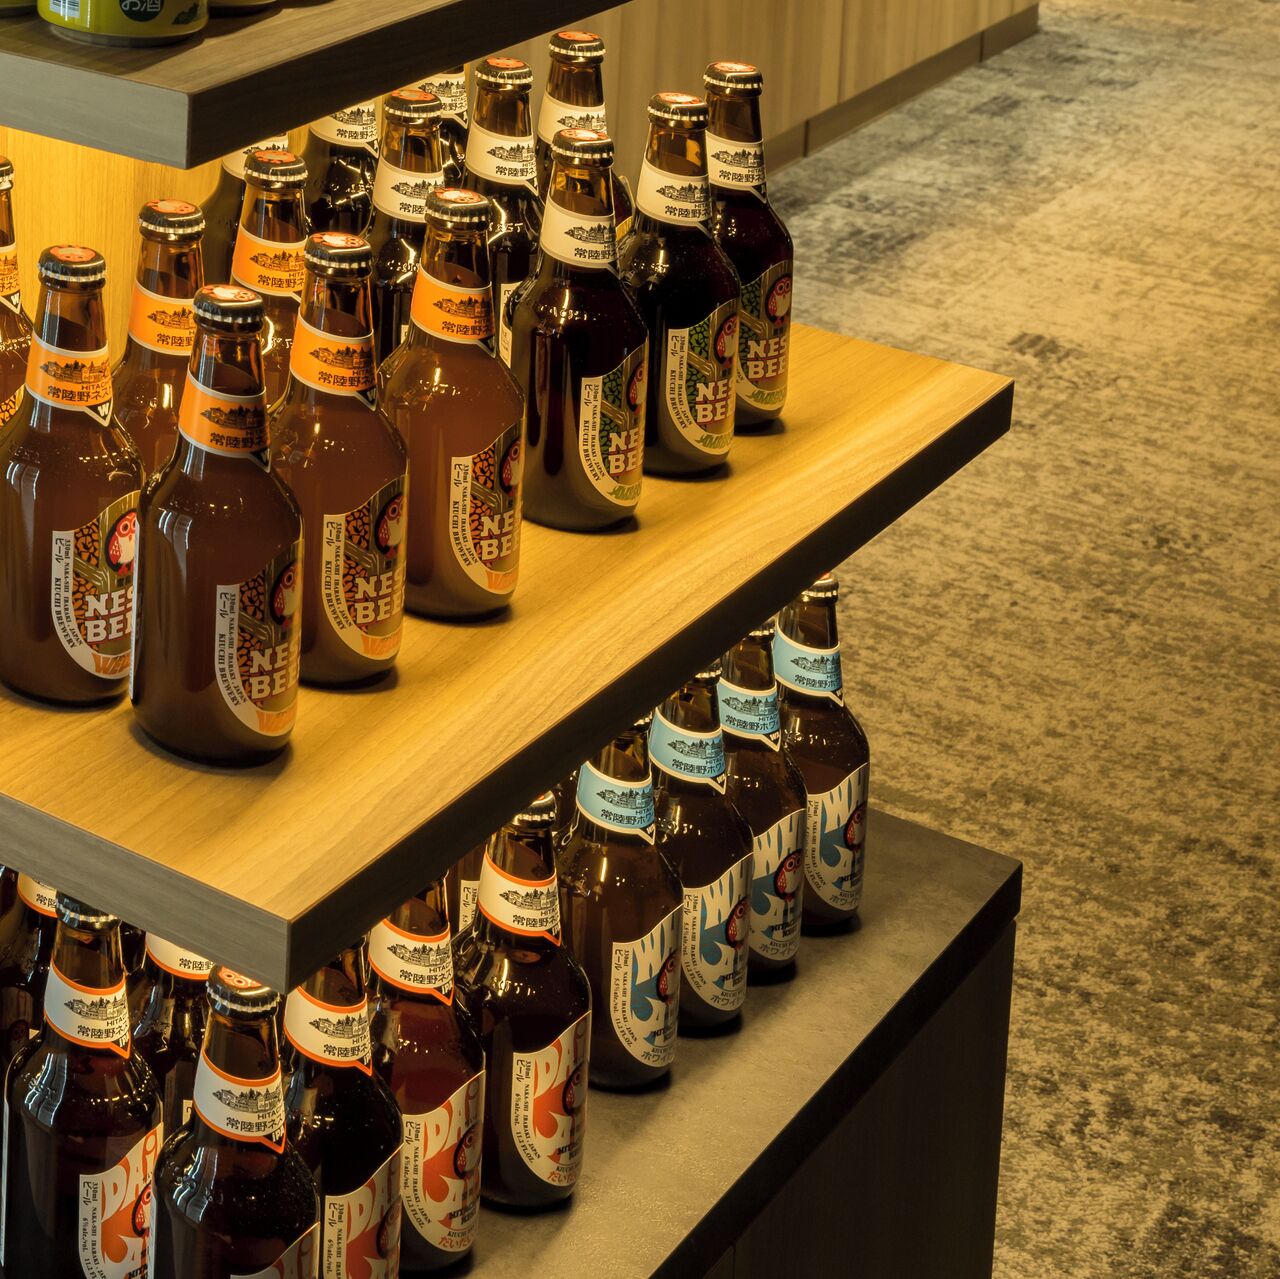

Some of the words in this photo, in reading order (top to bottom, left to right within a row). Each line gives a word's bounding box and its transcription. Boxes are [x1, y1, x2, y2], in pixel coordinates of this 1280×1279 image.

[671, 335, 680, 357] ビール
[47, 385, 110, 402] 常陸野ネス
[584, 383, 593, 407] ビール
[668, 397, 689, 430] BREWERY
[583, 420, 591, 449] KIUCHI
[454, 463, 463, 487] ビール
[583, 451, 601, 483] BREWERY
[452, 500, 460, 531] KIUCHI
[326, 521, 335, 546] ビール
[54, 537, 65, 564] ビール
[452, 531, 473, 567] BREWERY
[324, 560, 332, 589] KIUCHI
[53, 577, 61, 607] KIUCHI
[219, 592, 230, 619] ビール
[324, 591, 346, 631] BREWERY
[54, 610, 76, 649] BREWERY
[218, 665, 241, 707] BREWERY
[516, 1060, 524, 1082] ビール
[405, 1120, 413, 1144] ビール
[82, 1180, 92, 1206] ビール
